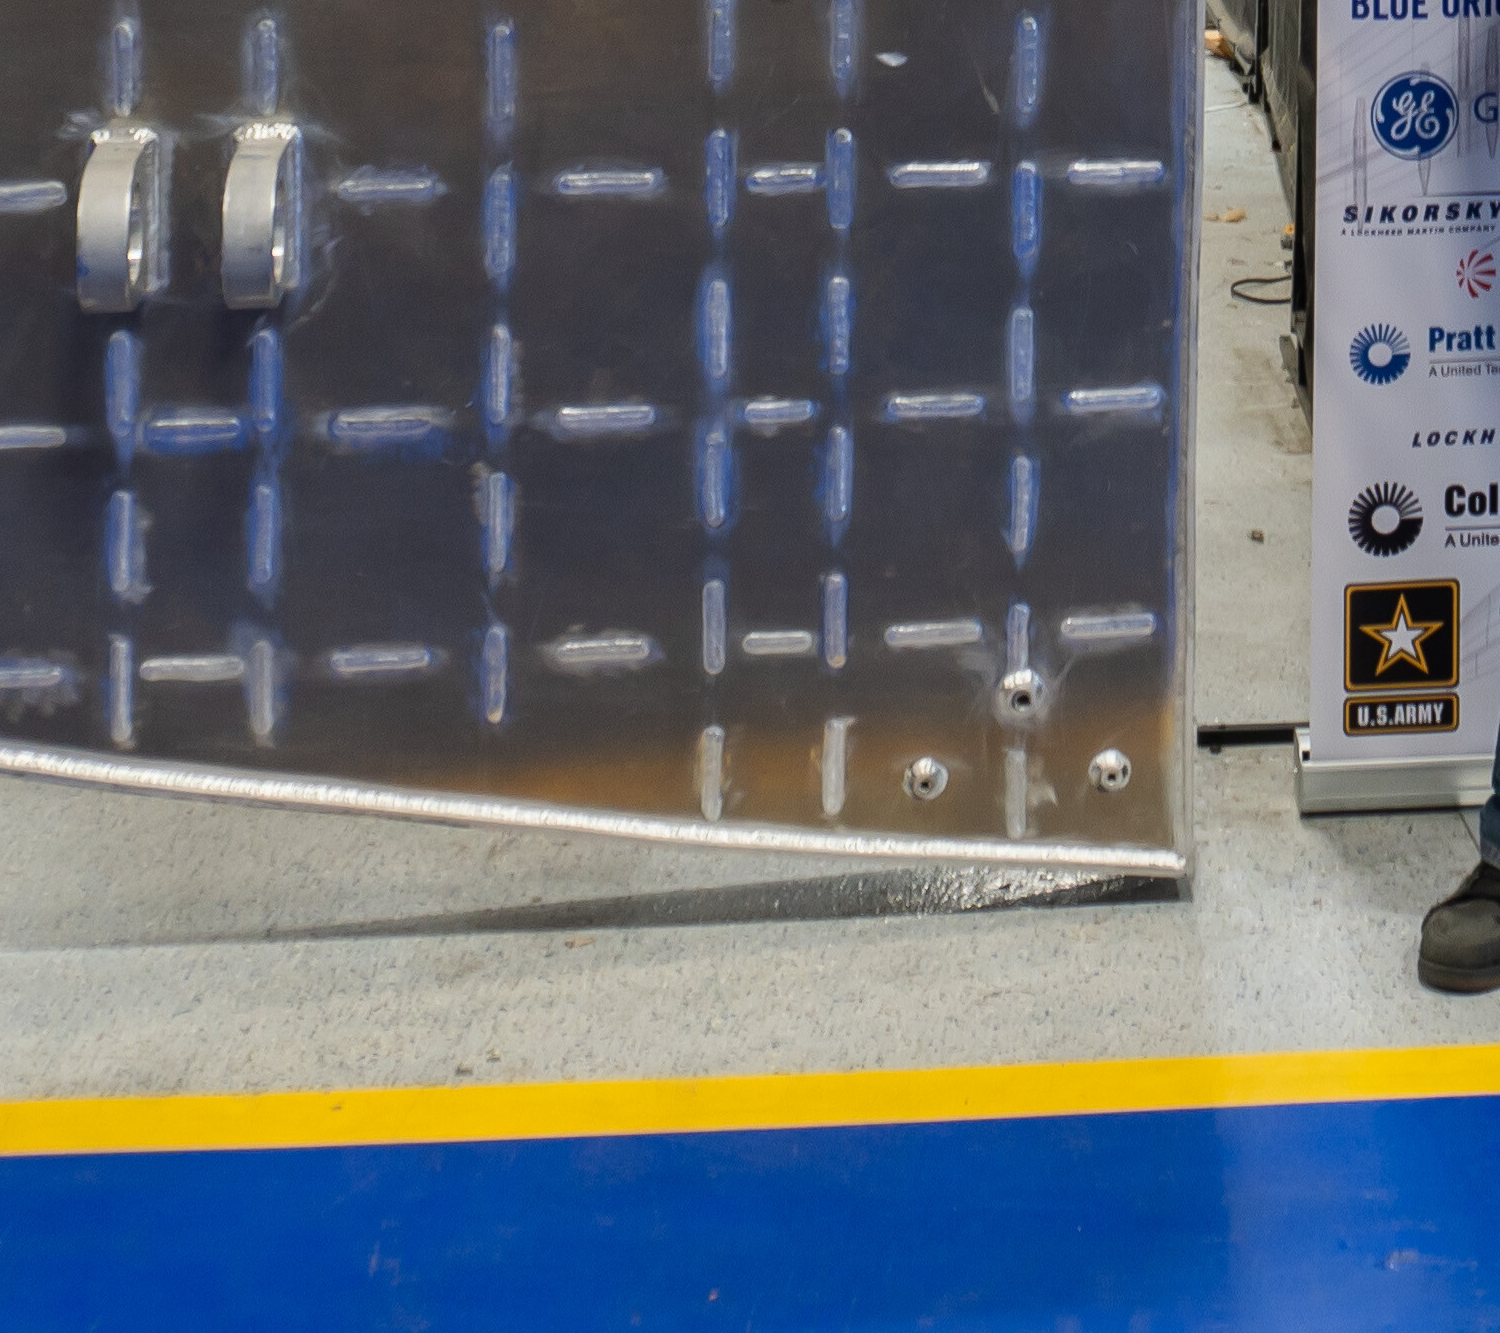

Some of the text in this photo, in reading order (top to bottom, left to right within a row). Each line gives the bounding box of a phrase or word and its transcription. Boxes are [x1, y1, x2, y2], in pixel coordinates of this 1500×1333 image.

[1428, 324, 1497, 352] Pratt
[1428, 364, 1482, 378] A United
[1445, 533, 1456, 548] A
